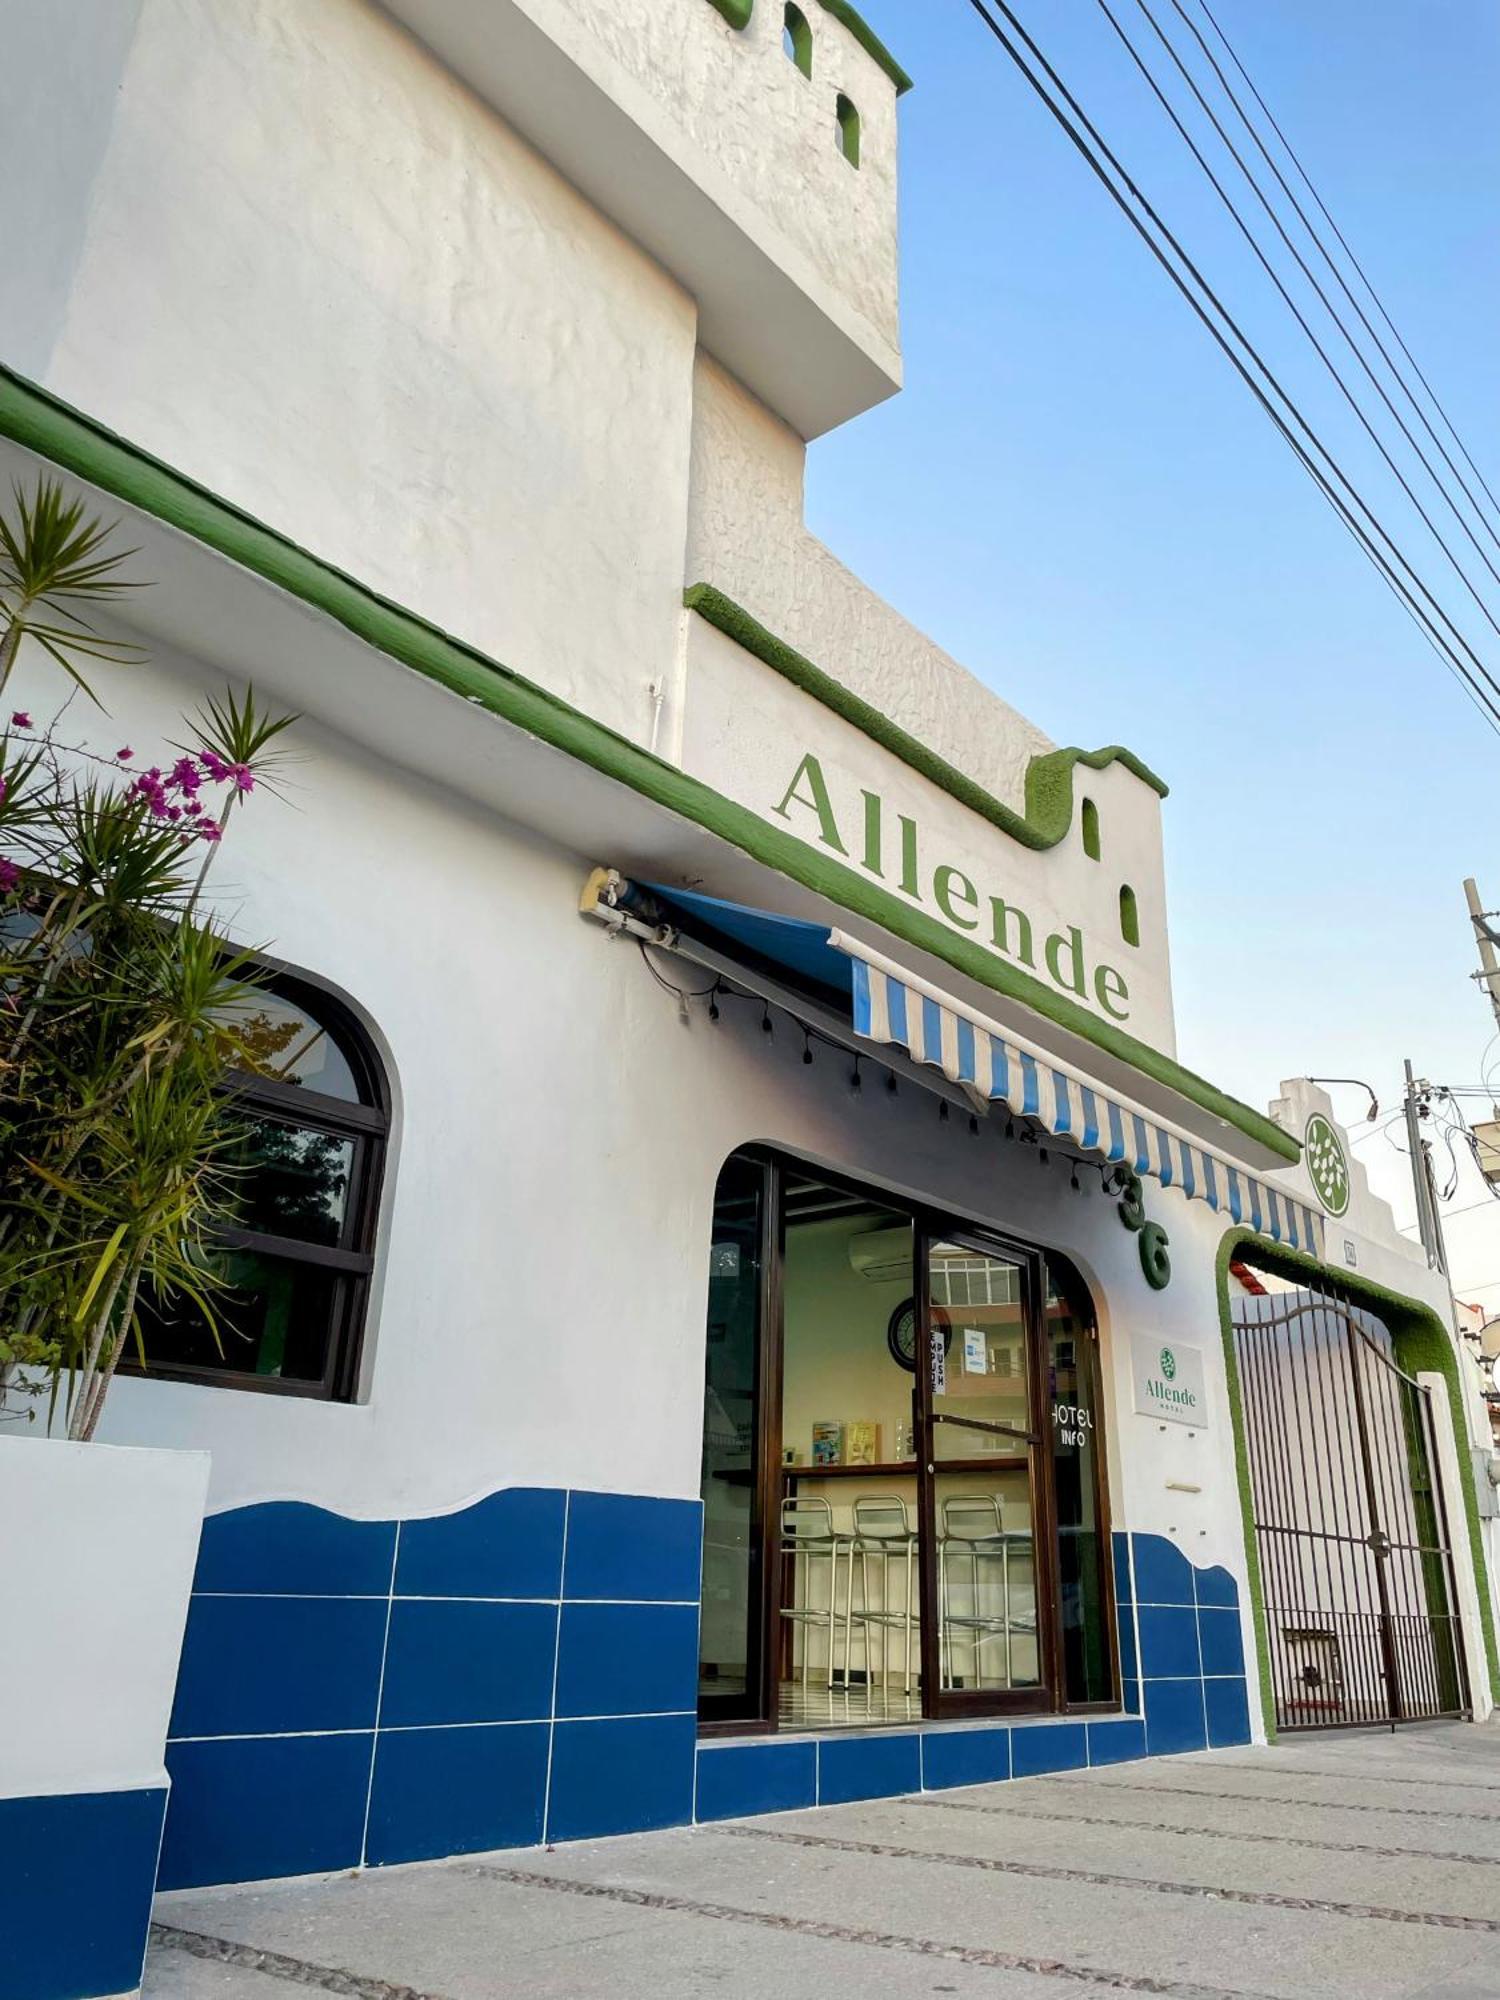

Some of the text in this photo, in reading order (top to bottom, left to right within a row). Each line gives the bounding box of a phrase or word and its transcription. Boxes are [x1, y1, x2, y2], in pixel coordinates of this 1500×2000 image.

[770, 752, 1131, 1022] Allende
[1145, 1379, 1196, 1407] Allende
[1061, 1429, 1085, 1447] INFO
